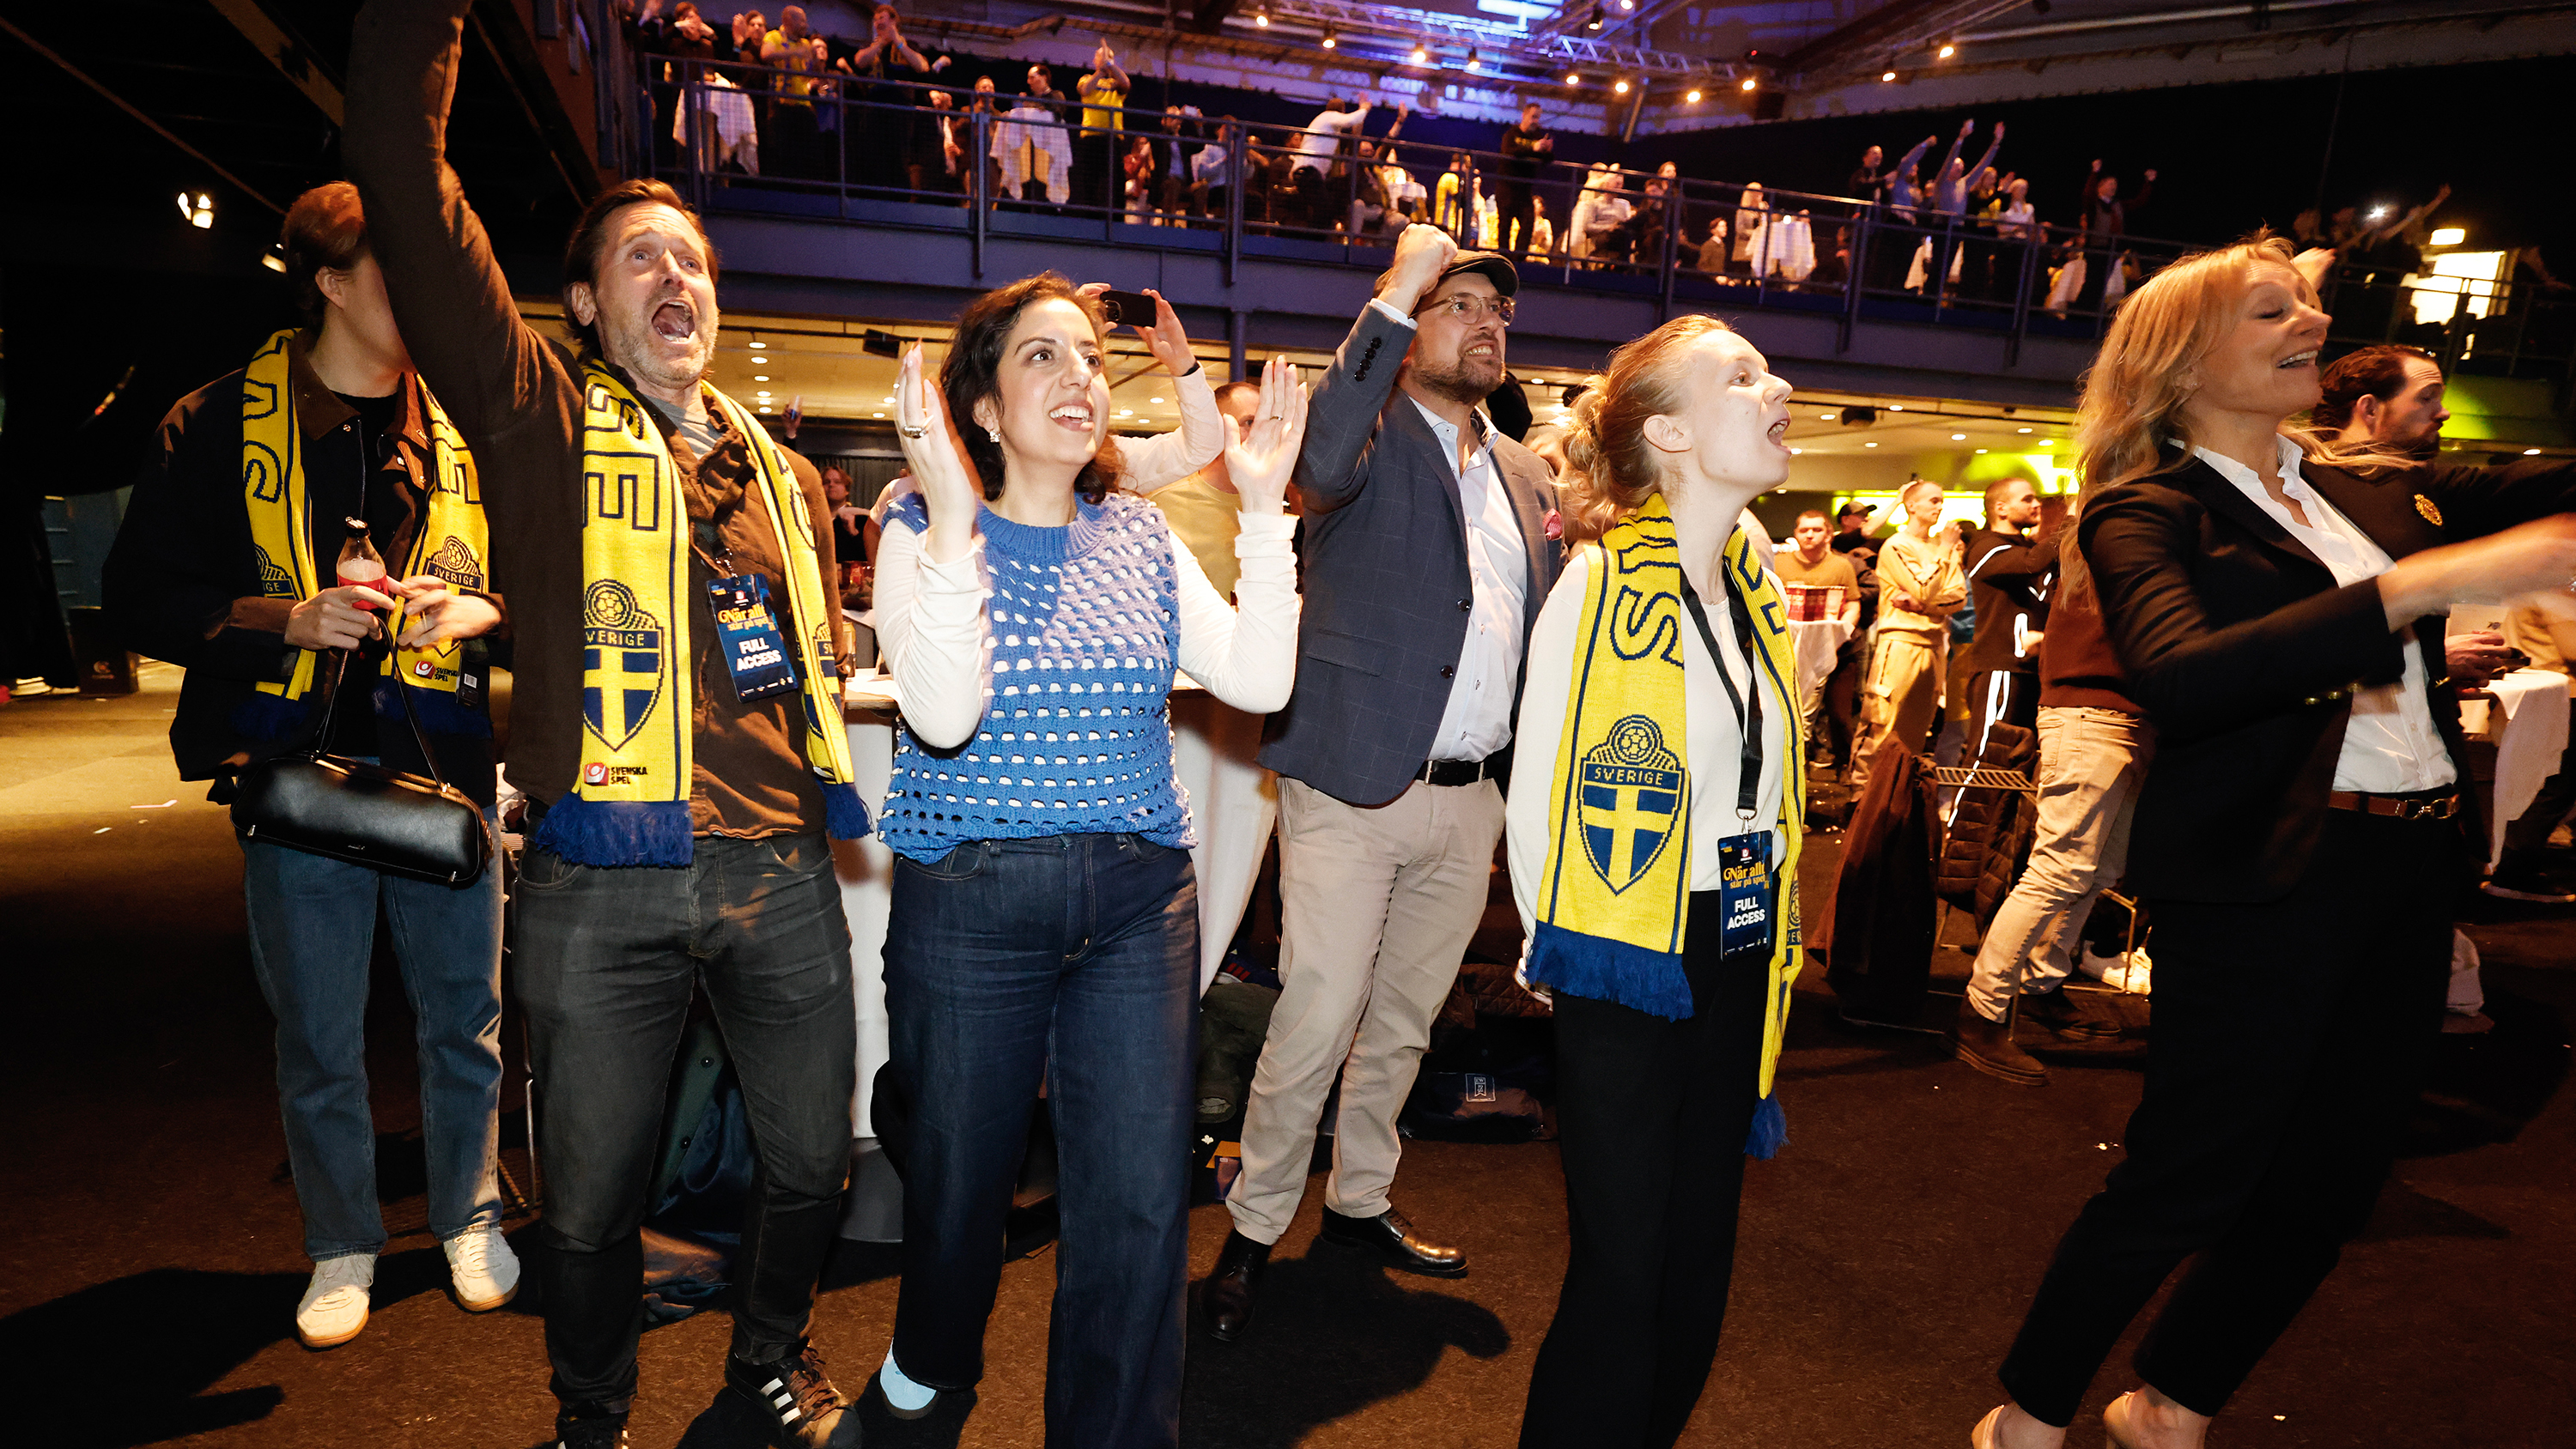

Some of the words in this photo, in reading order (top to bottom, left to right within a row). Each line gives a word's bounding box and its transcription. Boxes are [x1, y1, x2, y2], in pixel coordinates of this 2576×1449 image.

[434, 567, 474, 586] SVERIGE
[586, 630, 645, 646] VERIGE
[738, 637, 770, 655] FULL
[737, 649, 782, 671] ACCESS
[434, 674, 448, 682] SPEL
[611, 767, 648, 776] SVENSKA
[611, 776, 631, 785] SPEL
[1595, 767, 1664, 786] SVERIGE
[1723, 864, 1748, 882] När
[1749, 861, 1765, 877] allt
[1735, 896, 1759, 913] FULL
[1727, 908, 1765, 931] ACCESS
